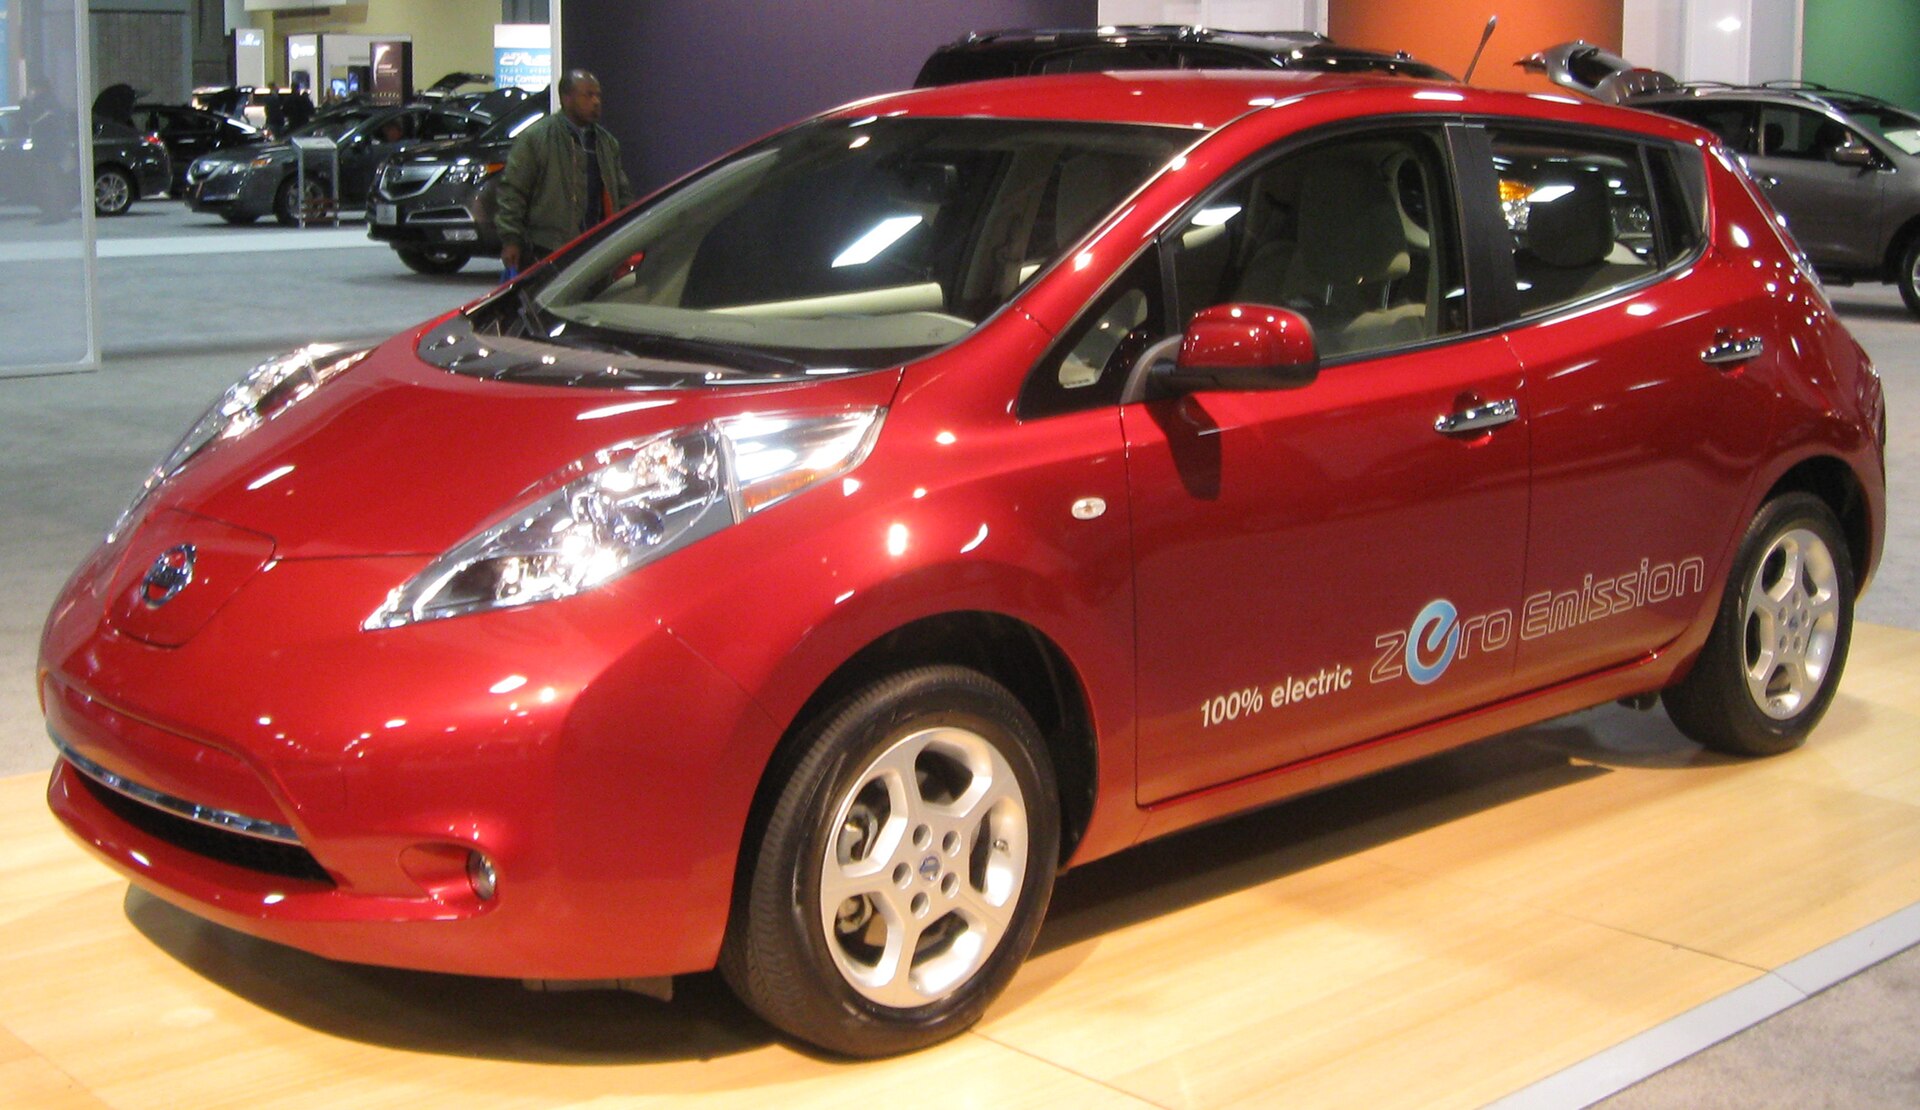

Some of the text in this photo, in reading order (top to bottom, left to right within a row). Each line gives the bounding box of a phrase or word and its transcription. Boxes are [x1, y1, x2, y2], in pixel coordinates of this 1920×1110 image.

[1520, 557, 1705, 641] Emission
[1201, 664, 1353, 728] 100% electric
